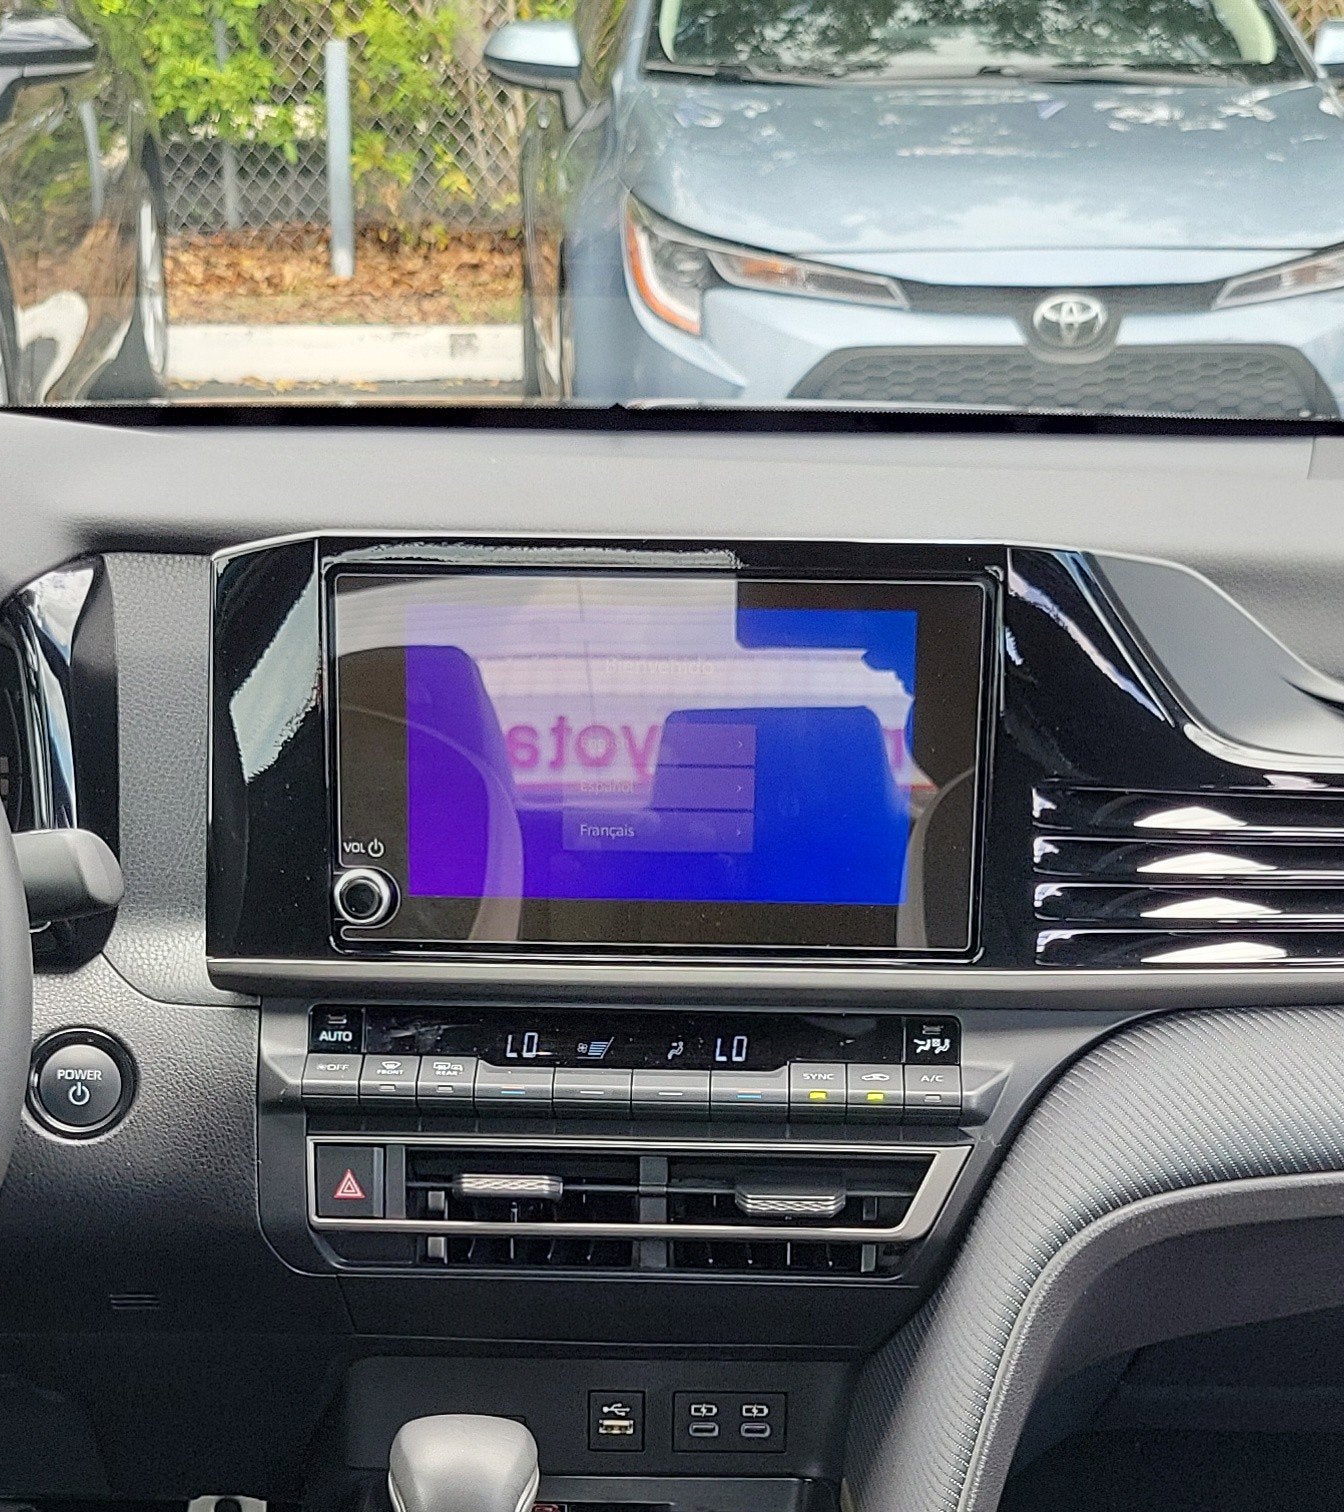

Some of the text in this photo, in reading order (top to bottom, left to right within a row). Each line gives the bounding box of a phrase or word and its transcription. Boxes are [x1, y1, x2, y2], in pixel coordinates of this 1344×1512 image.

[579, 824, 635, 840] Français
[342, 842, 366, 853] VOL
[318, 1030, 353, 1042] AUTO
[506, 1032, 538, 1058] LO
[715, 1035, 748, 1062] LO
[327, 1063, 349, 1071] OFF
[57, 1069, 103, 1081] POWER
[802, 1073, 835, 1081] SYNC
[920, 1075, 944, 1083] A/C
